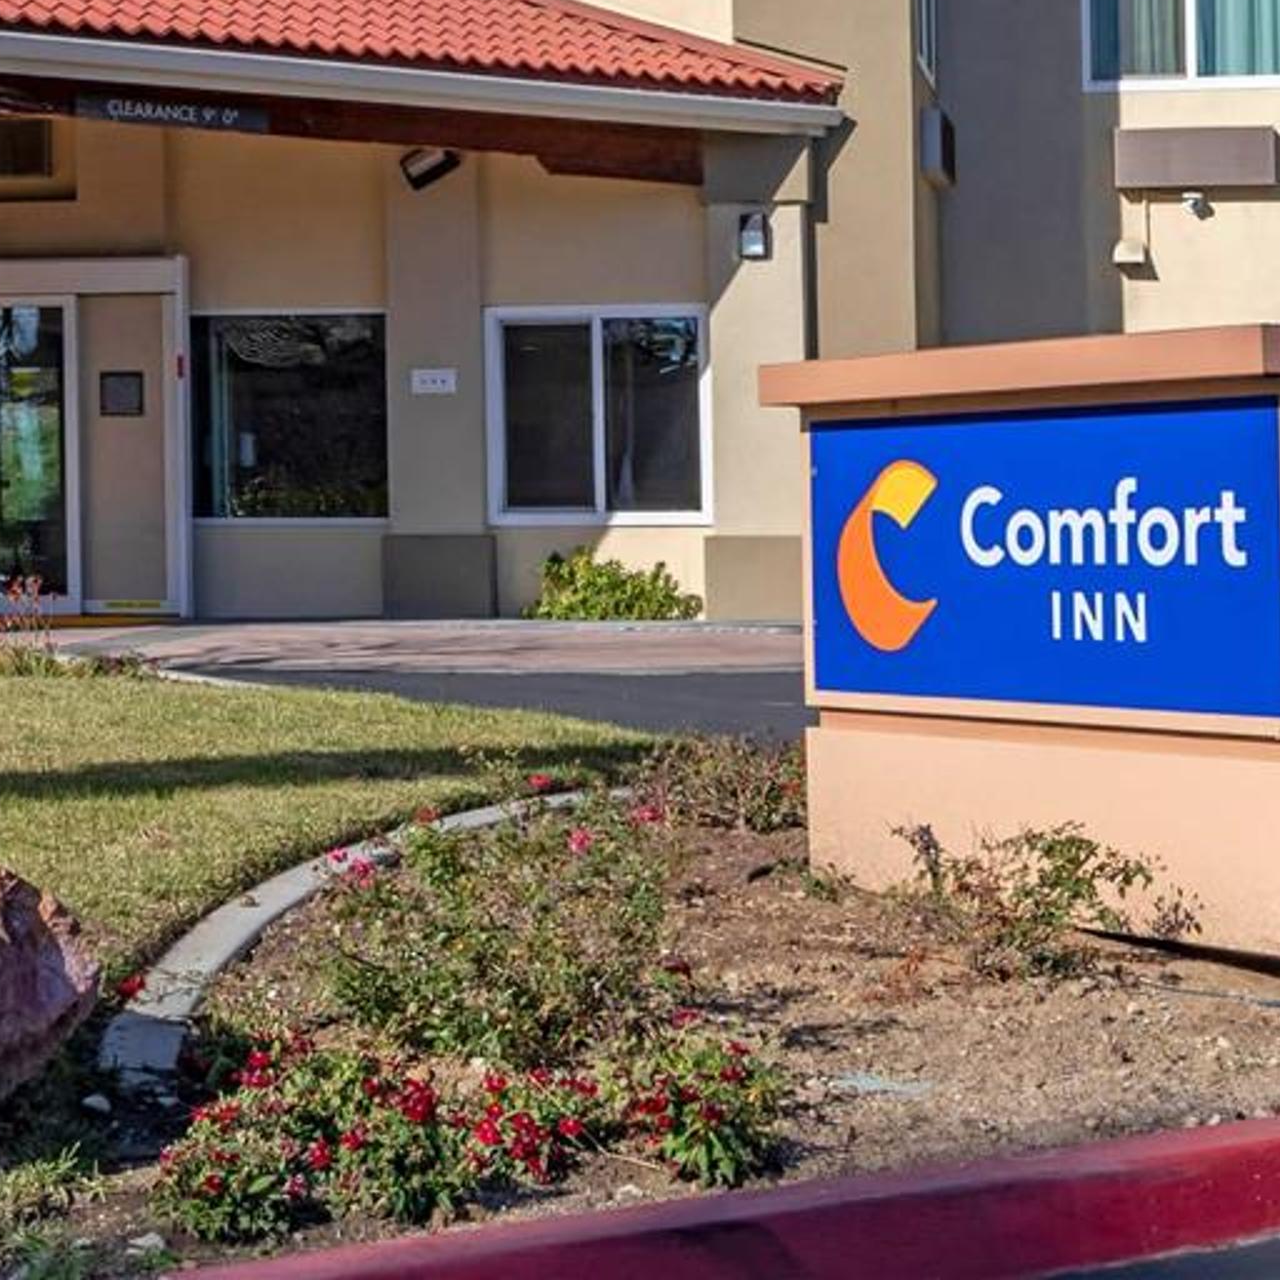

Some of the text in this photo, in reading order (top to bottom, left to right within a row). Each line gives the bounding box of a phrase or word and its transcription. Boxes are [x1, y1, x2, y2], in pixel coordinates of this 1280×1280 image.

[107, 98, 198, 122] CLEARANCE
[961, 477, 1248, 568] Comfort
[1051, 590, 1147, 643] INN
